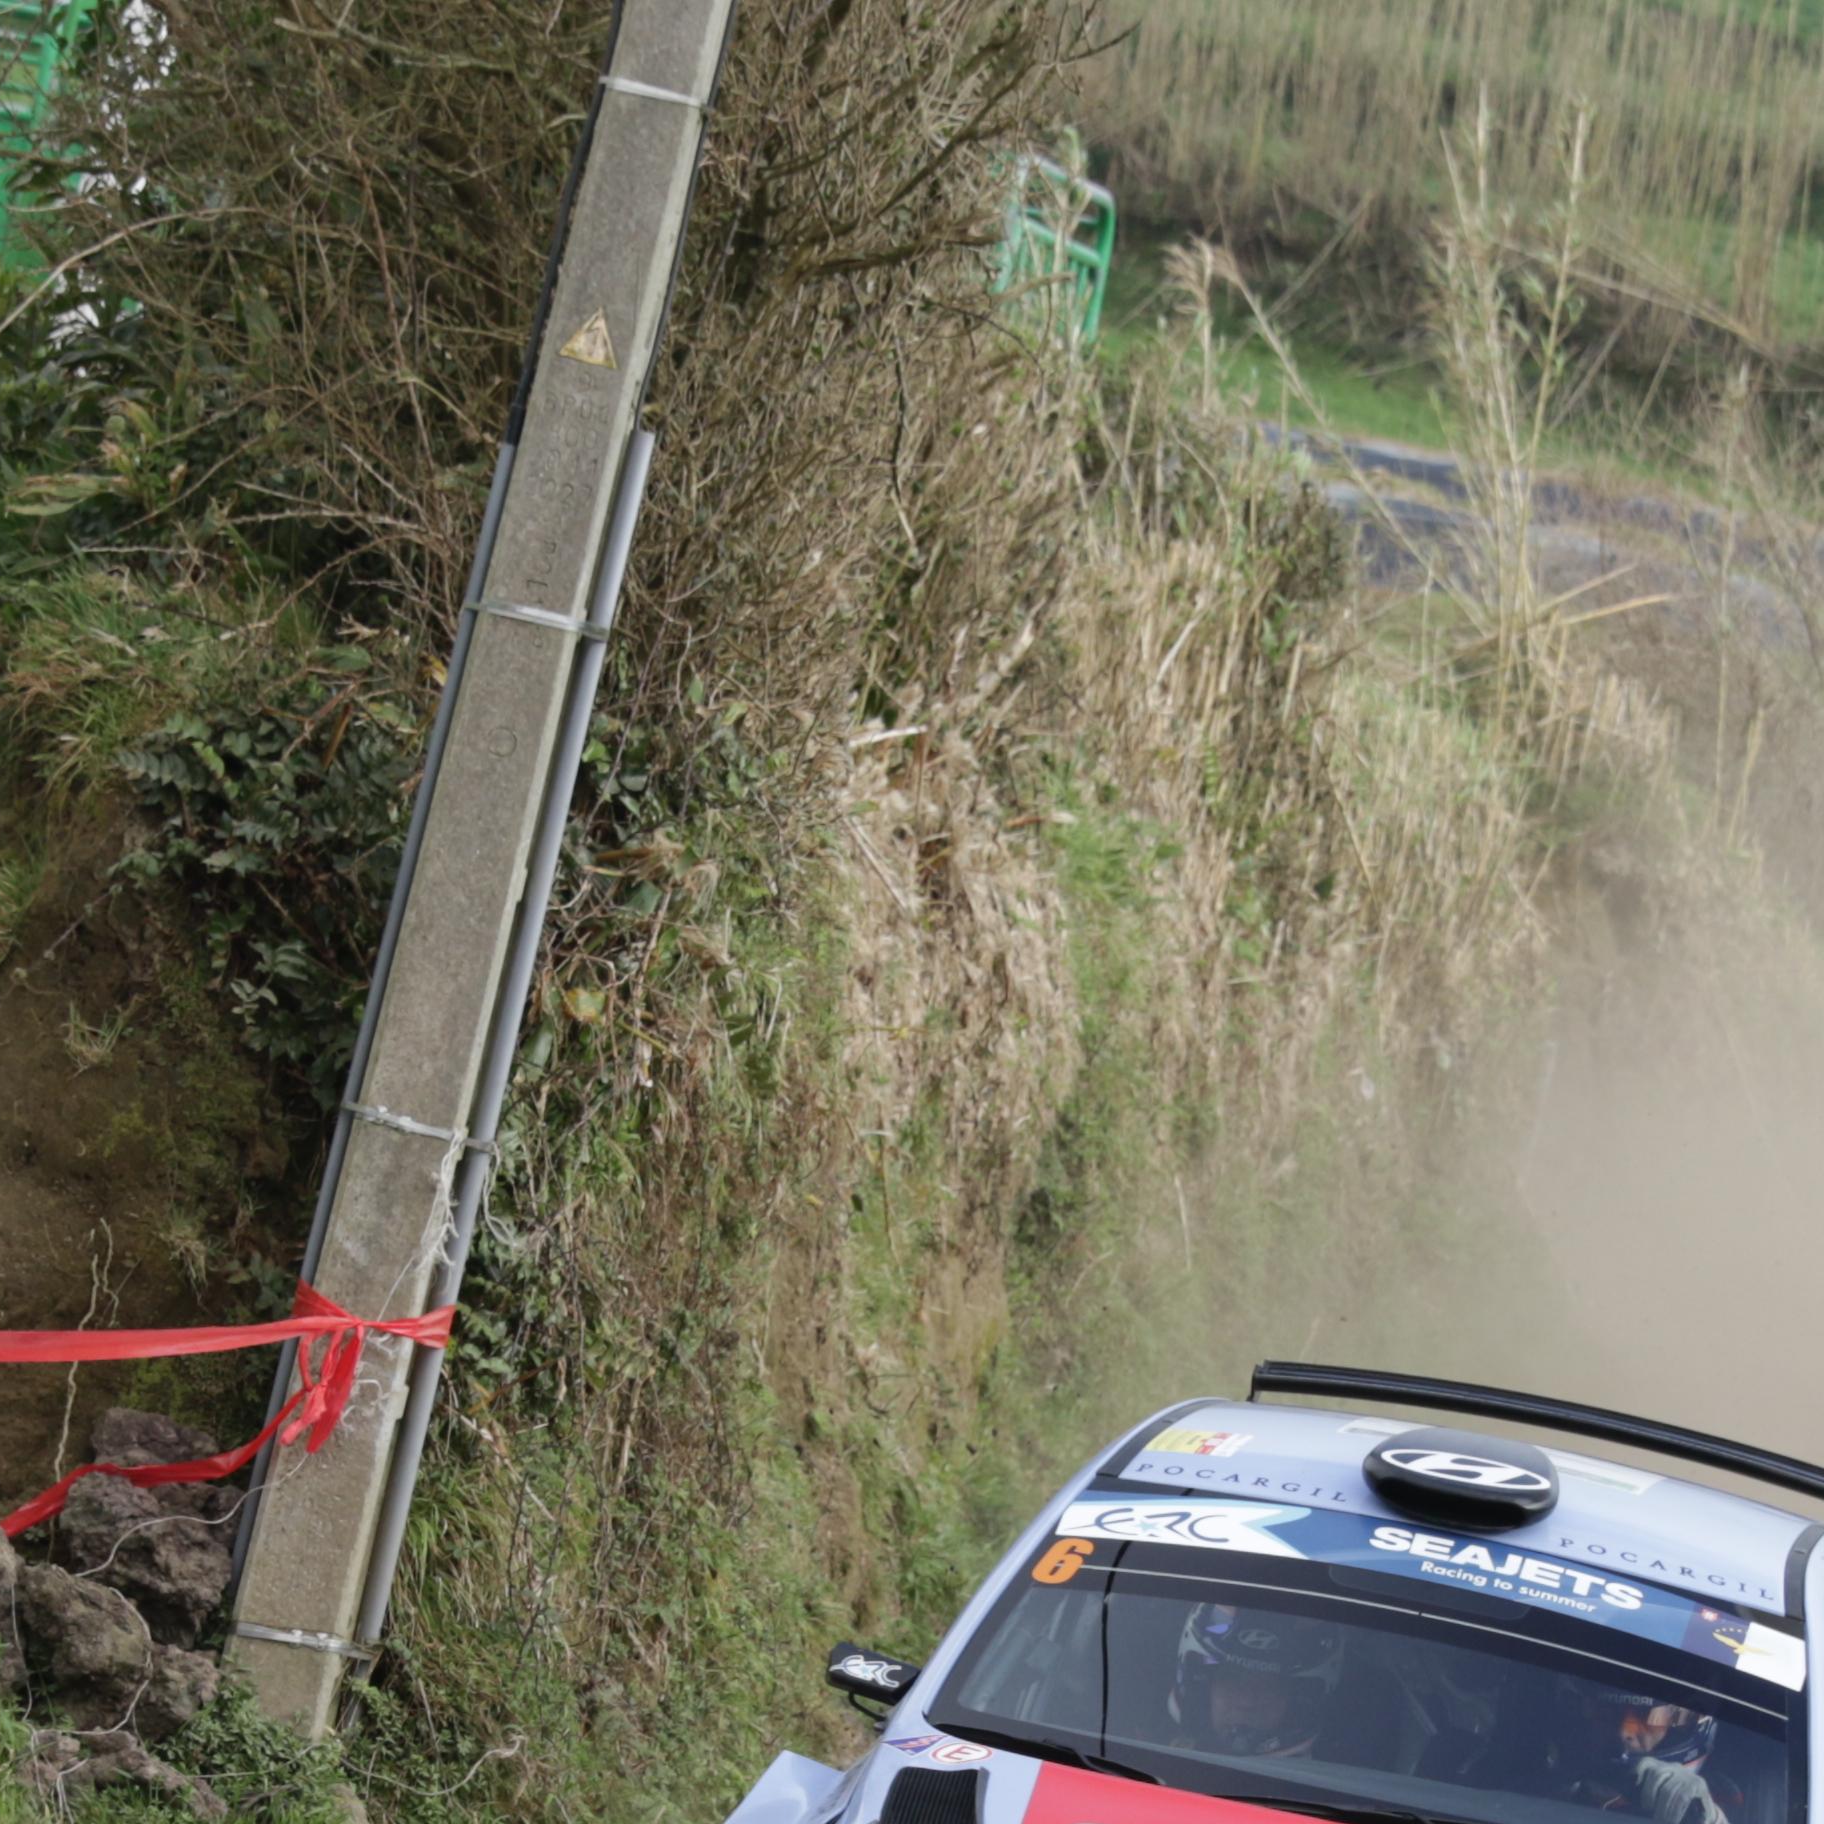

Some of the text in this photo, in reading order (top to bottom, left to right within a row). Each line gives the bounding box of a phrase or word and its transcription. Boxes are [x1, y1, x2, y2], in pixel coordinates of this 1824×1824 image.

[1135, 1463, 1347, 1503] POCARGIL
[1033, 1538, 1094, 1585] 6
[1369, 1526, 1644, 1611] SEAJETS
[1420, 1560, 1597, 1615] Racing to summer
[1559, 1537, 1775, 1601] POCARGIL
